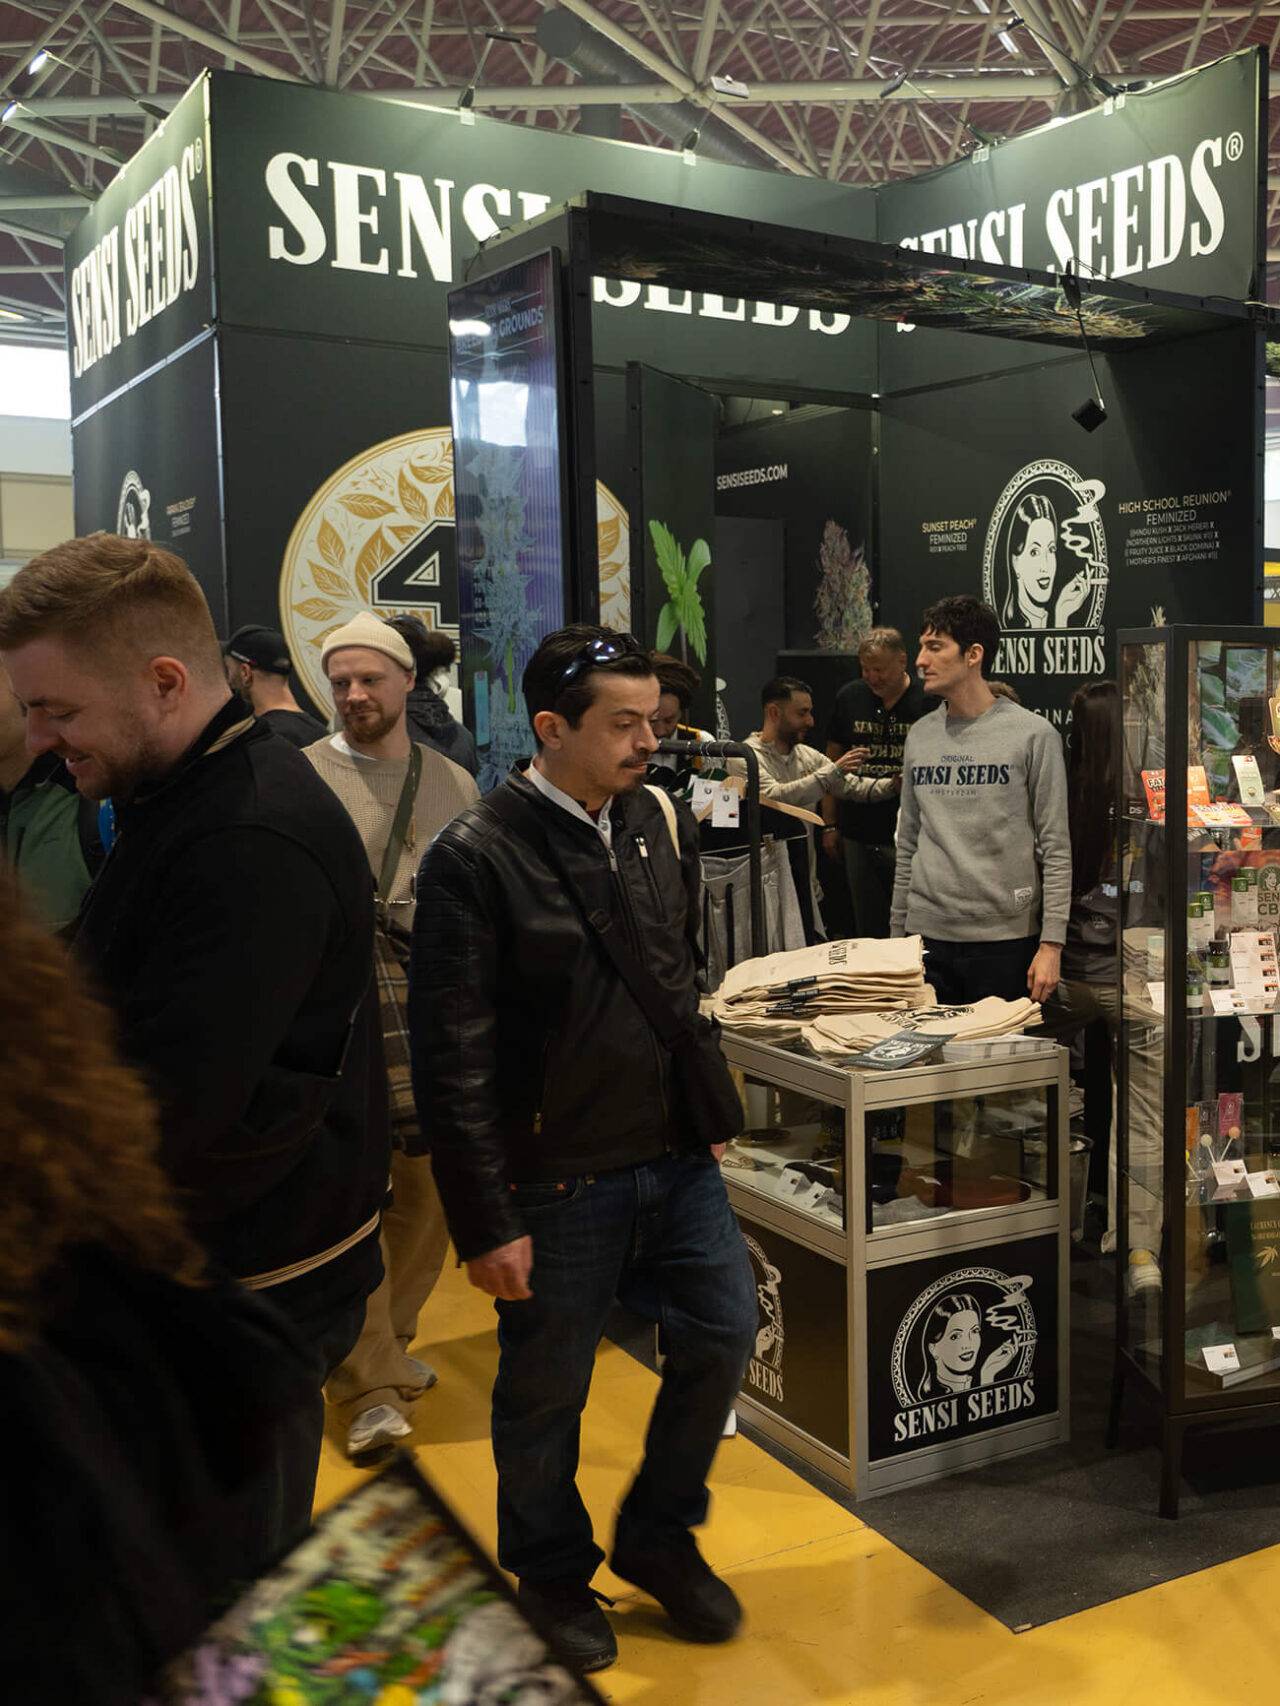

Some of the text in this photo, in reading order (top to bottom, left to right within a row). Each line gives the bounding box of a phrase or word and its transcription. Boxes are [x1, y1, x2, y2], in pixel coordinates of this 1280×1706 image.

[265, 152, 551, 283] SENS
[71, 225, 121, 379] SENSI
[716, 463, 788, 490] SENSISEEDS.COM
[1118, 502, 1141, 514] HIGH
[1143, 497, 1180, 512] SCHOOL
[1146, 509, 1197, 525] FEMINIZED
[921, 521, 948, 533] SUNSET
[929, 532, 968, 545] FEMINIZED
[990, 635, 1107, 675] ENSI SEEDS
[912, 764, 1010, 785] SENSI SEEDS
[749, 1359, 784, 1402] SEEDS
[893, 1378, 1036, 1442] SENSI SEEDS
